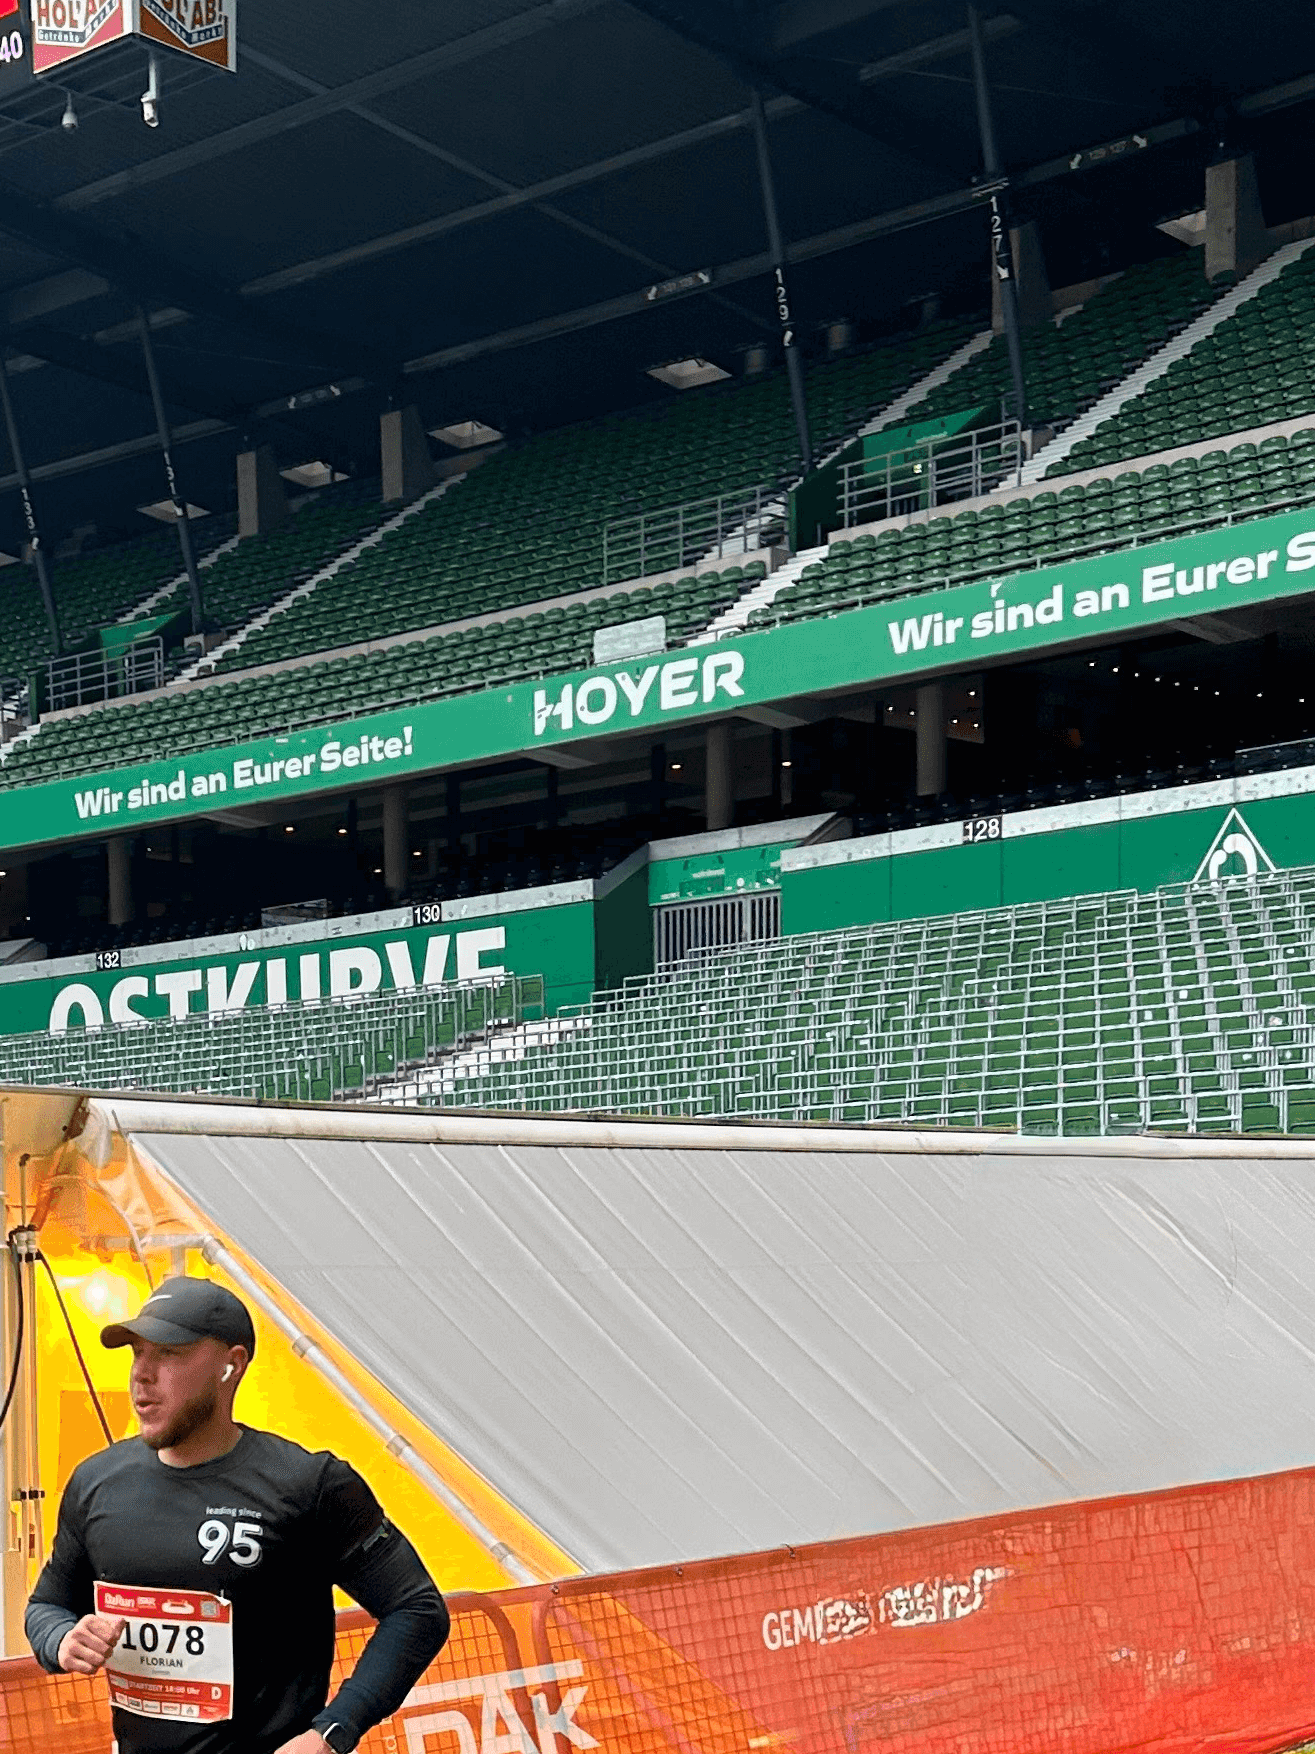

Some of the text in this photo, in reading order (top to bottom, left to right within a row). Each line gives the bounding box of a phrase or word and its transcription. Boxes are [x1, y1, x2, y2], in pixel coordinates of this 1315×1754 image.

[990, 196, 1002, 251] 127
[775, 267, 789, 320] 129
[887, 611, 964, 655] Wir
[970, 584, 1064, 639] sind
[1073, 582, 1130, 617] an
[1142, 549, 1278, 603] Eurer
[534, 650, 745, 736] HOYER
[74, 726, 413, 818] Wir sind an Eurer Seite!
[965, 819, 1001, 841] 128
[414, 905, 440, 924] 130
[97, 952, 120, 968] 132
[197, 1519, 264, 1568] 95
[122, 1621, 204, 1656] 1078
[140, 1656, 183, 1668] FLORIAN
[211, 1686, 222, 1700] D
